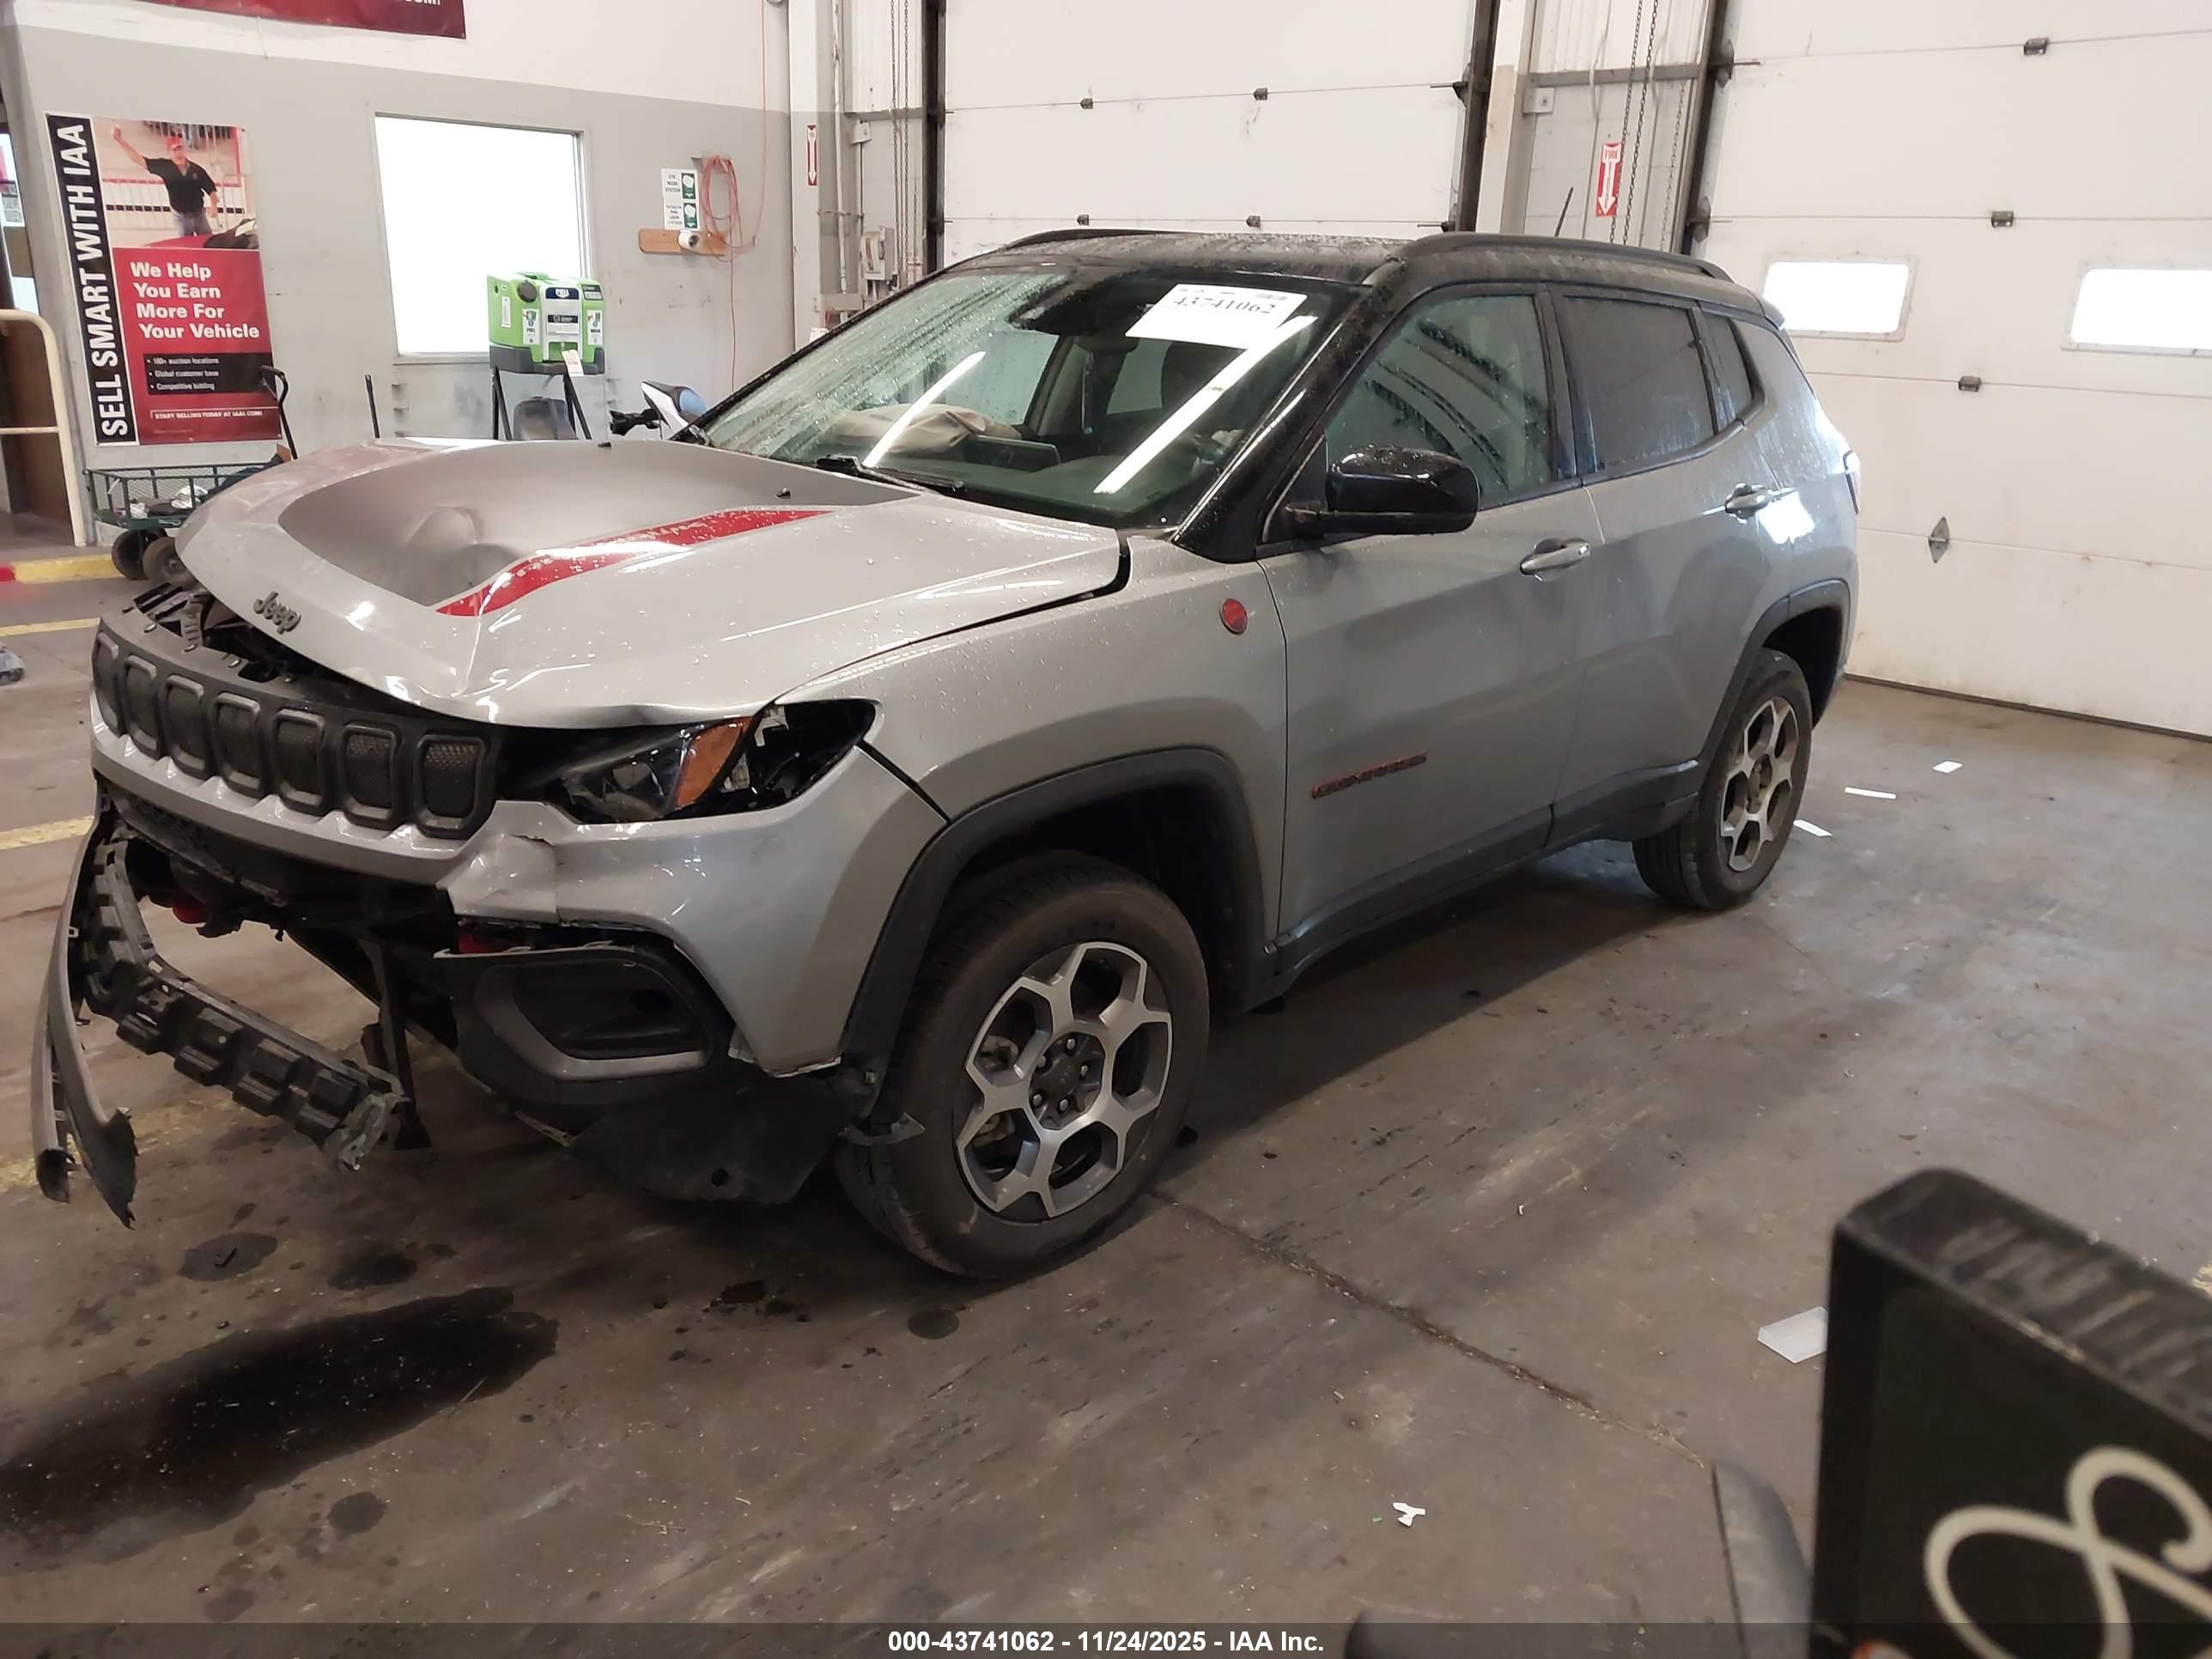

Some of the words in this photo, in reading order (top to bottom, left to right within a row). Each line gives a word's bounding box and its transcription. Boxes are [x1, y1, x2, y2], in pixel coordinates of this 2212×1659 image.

[58, 124, 92, 176] IAA
[66, 185, 104, 261] WITH
[131, 262, 161, 277] We
[167, 262, 211, 282] Help
[133, 283, 171, 298] You
[176, 283, 221, 299] Earn
[79, 267, 118, 368] SMART
[136, 302, 187, 319] More
[193, 303, 224, 319] For
[139, 323, 185, 338] Your
[189, 323, 260, 338] Vehicle
[156, 383, 193, 392] Competitive
[95, 374, 128, 436] SELL
[252, 591, 302, 635] Jeep
